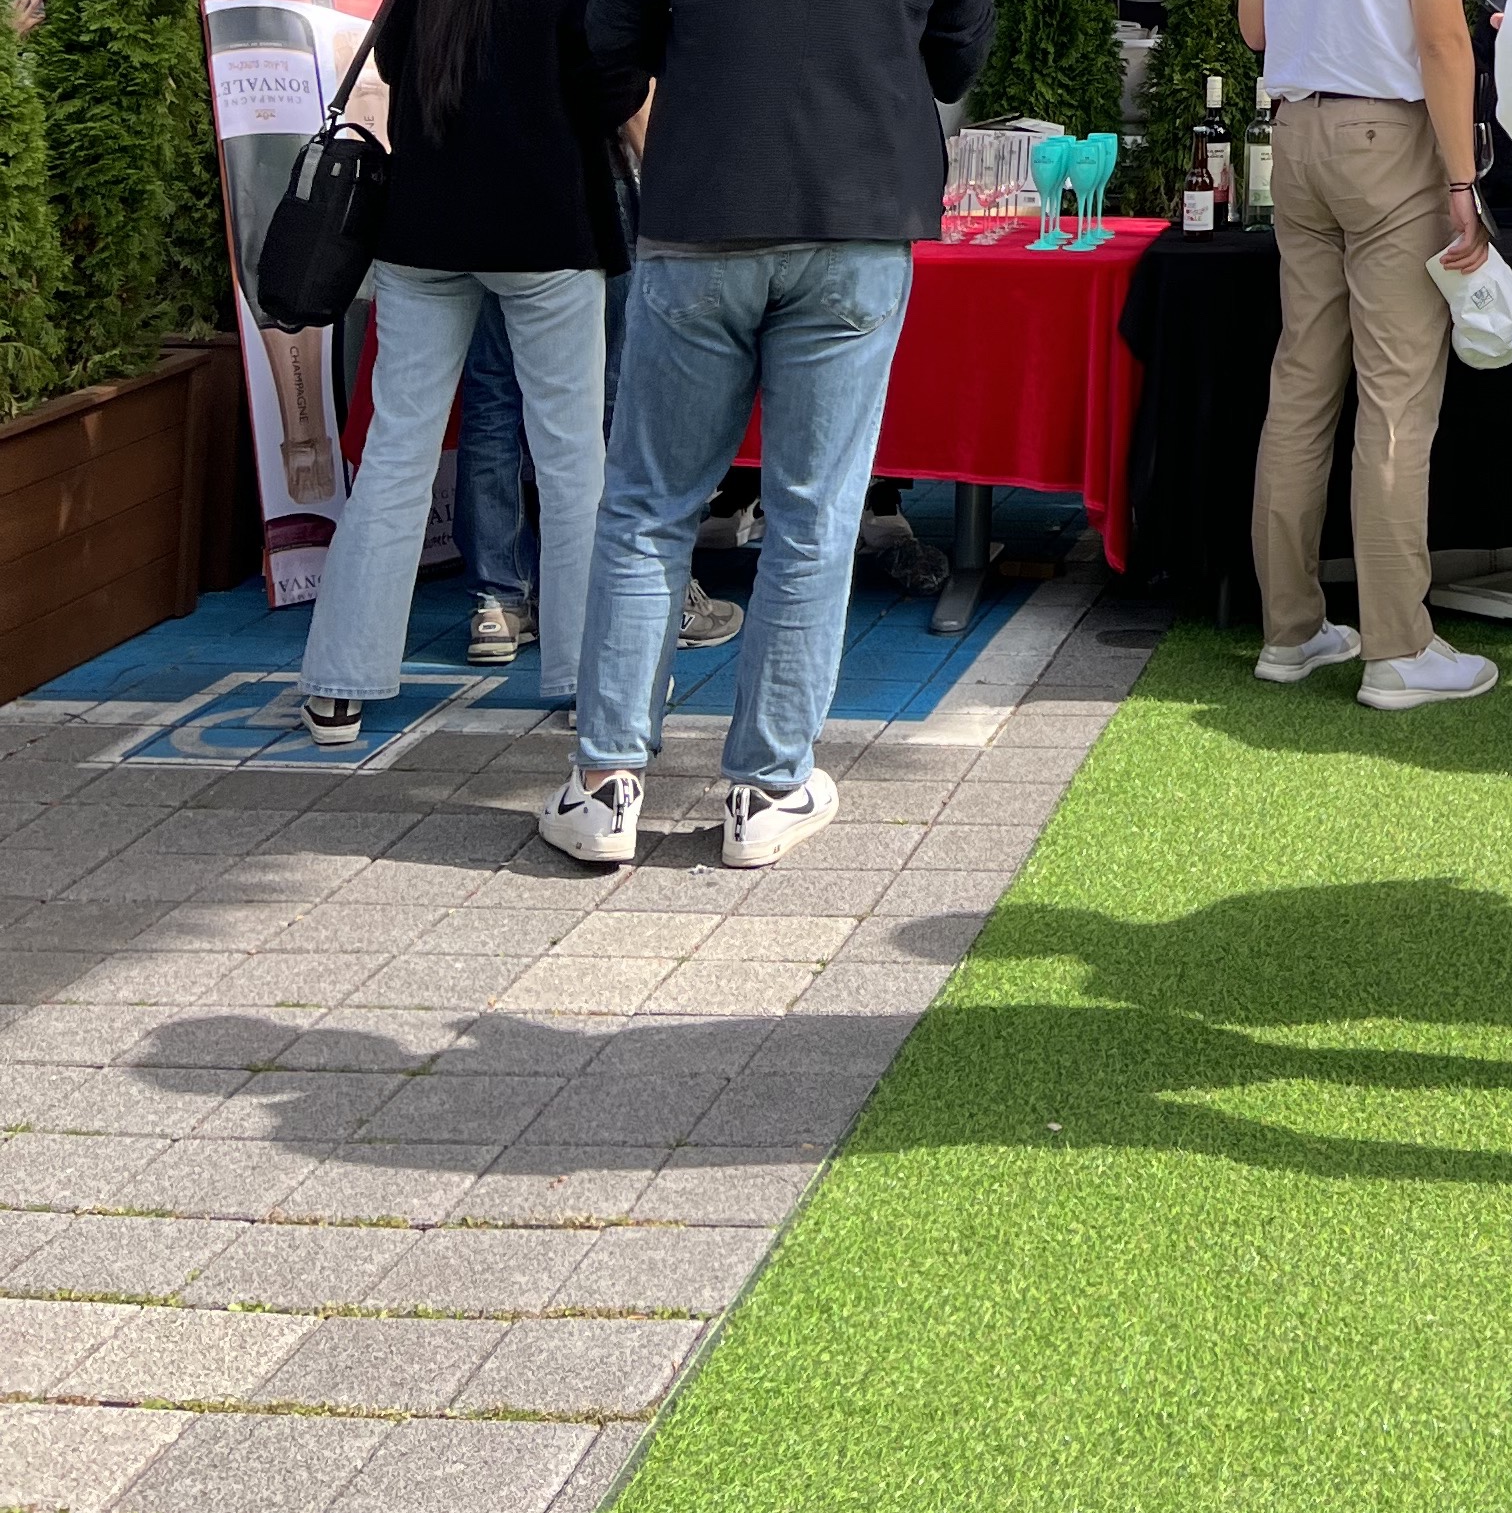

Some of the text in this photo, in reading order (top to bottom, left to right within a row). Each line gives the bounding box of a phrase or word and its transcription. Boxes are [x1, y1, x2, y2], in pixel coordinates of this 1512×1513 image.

[218, 77, 311, 96] BONVALE
[223, 95, 302, 108] CHAMPAGNE
[289, 344, 309, 425] CHAMPAGNE
[278, 574, 321, 594] NVA
